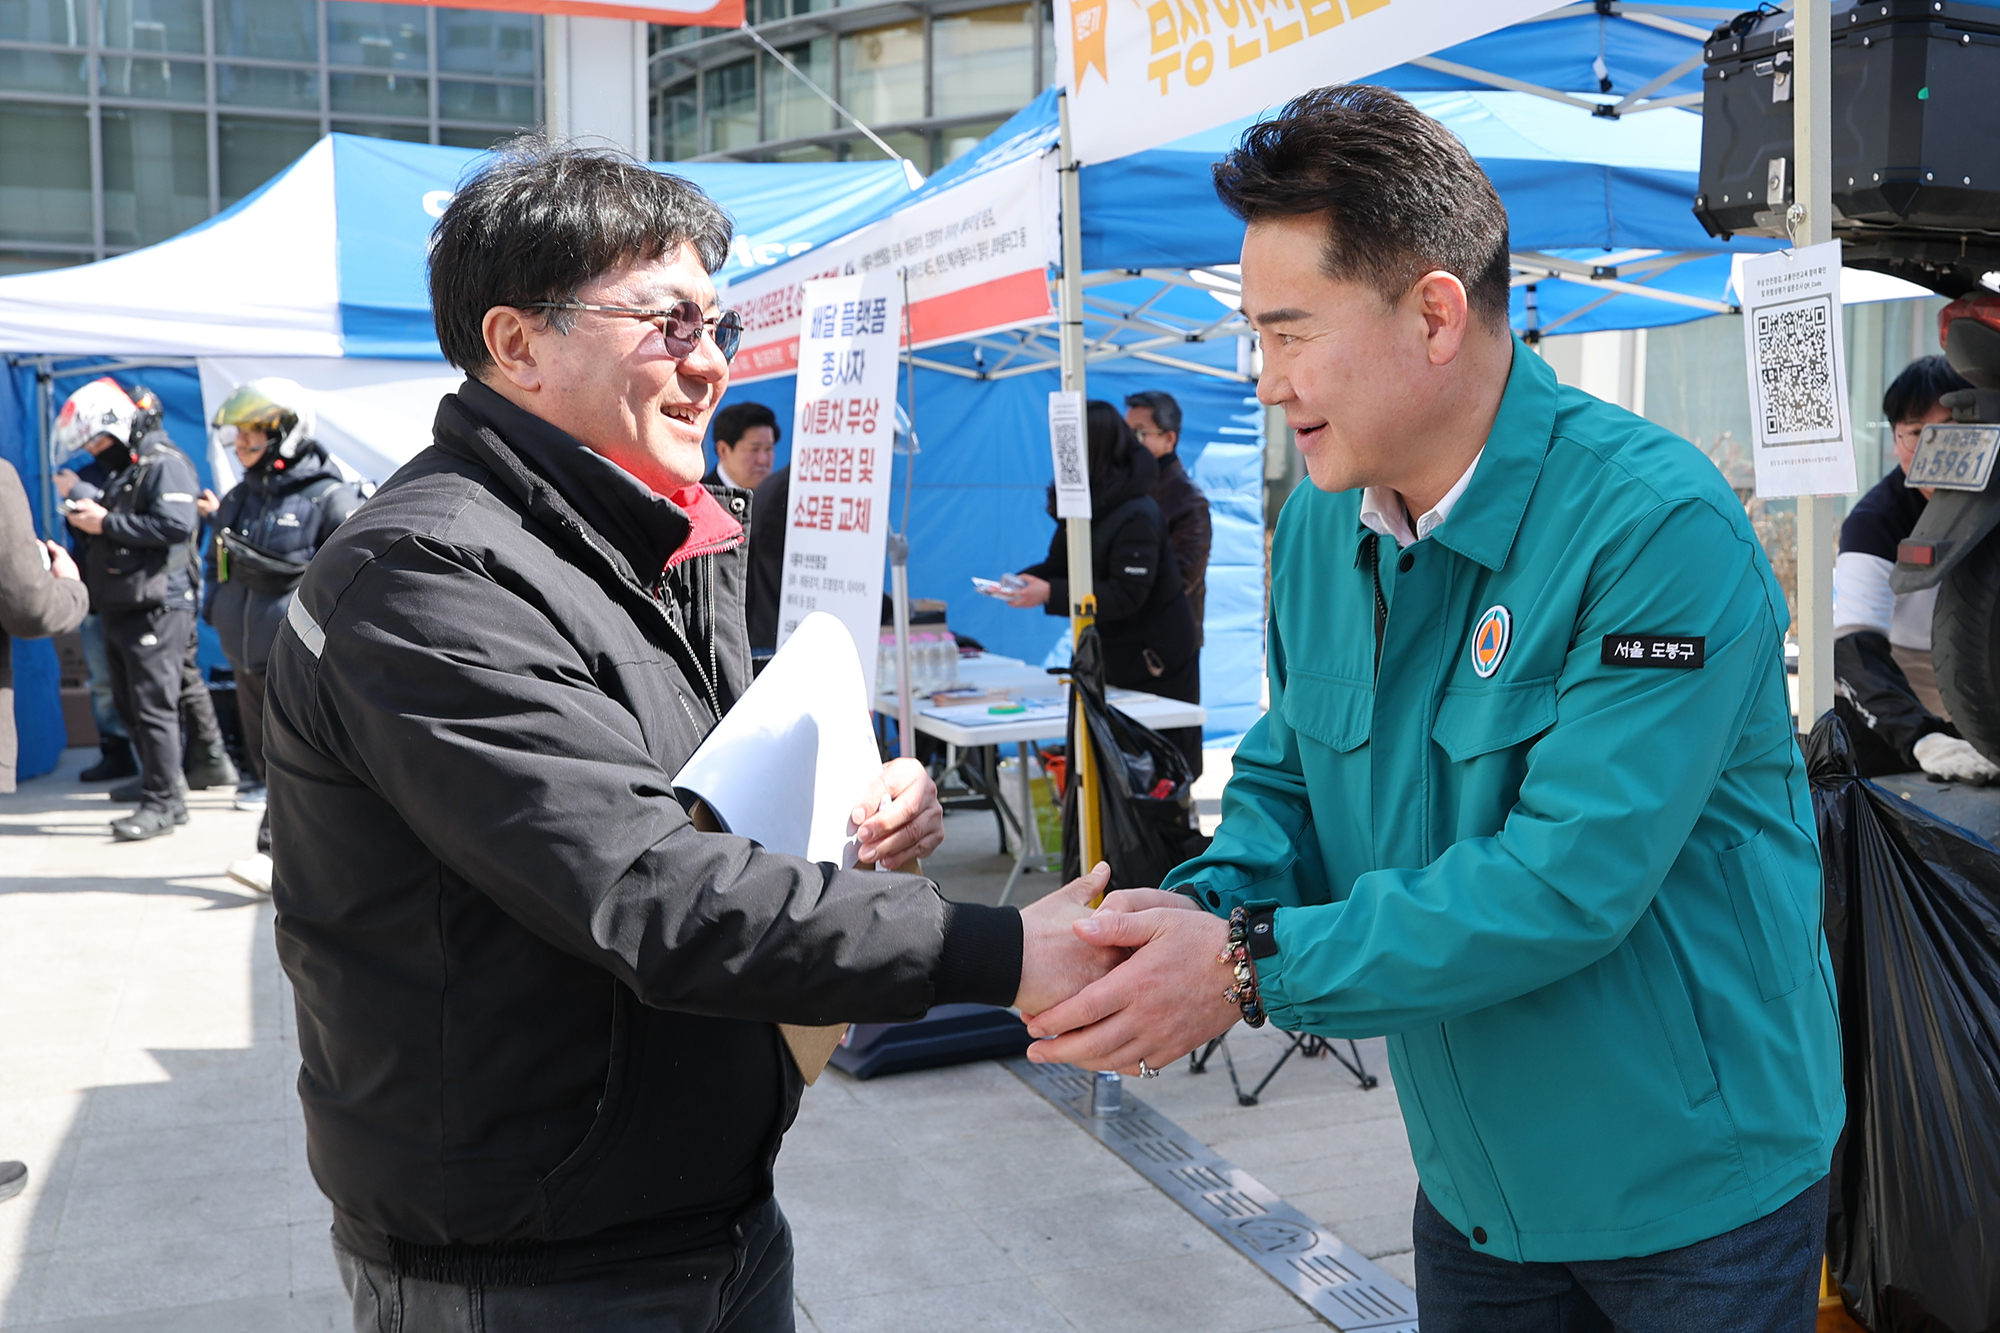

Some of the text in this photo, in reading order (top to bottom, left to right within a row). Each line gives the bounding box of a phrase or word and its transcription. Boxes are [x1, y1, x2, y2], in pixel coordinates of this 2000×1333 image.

[811, 302, 837, 339] 배달
[841, 297, 887, 337] 플랫폼
[822, 349, 865, 386] 종사자
[802, 398, 879, 435] 이륜차 무상
[798, 448, 875, 483] 안전점검 및
[1929, 450, 1986, 480] 5961
[794, 496, 872, 534] 소모품 교체
[1614, 640, 1695, 660] 서울 도봉구
